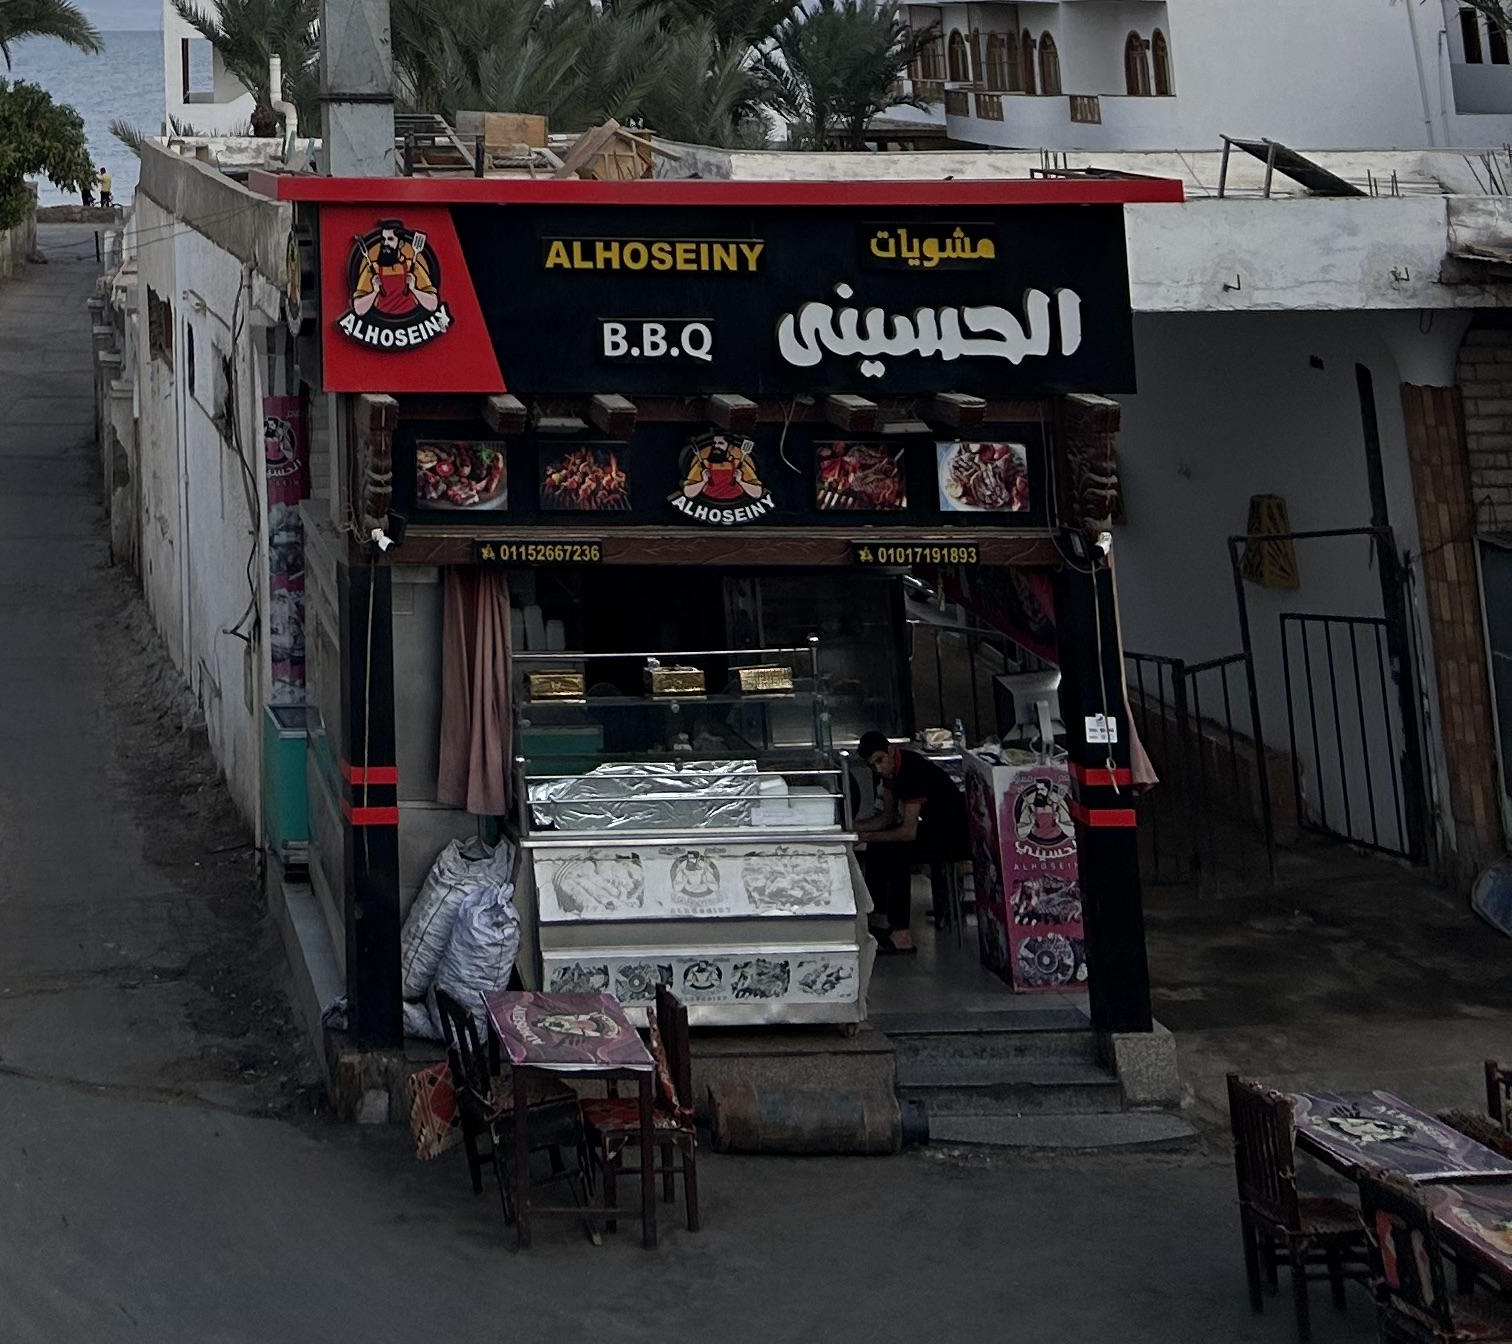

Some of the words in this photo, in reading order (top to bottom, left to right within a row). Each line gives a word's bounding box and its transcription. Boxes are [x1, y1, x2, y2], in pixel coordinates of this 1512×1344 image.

[545, 240, 764, 272] ALHOSEINY
[870, 226, 996, 268] مشويات
[338, 304, 451, 347] ALHOSEINY
[602, 322, 714, 362] B.B.Q
[671, 493, 776, 525] ALHOSEINY
[499, 543, 601, 562] 01152667236
[877, 546, 978, 564] 01017191893
